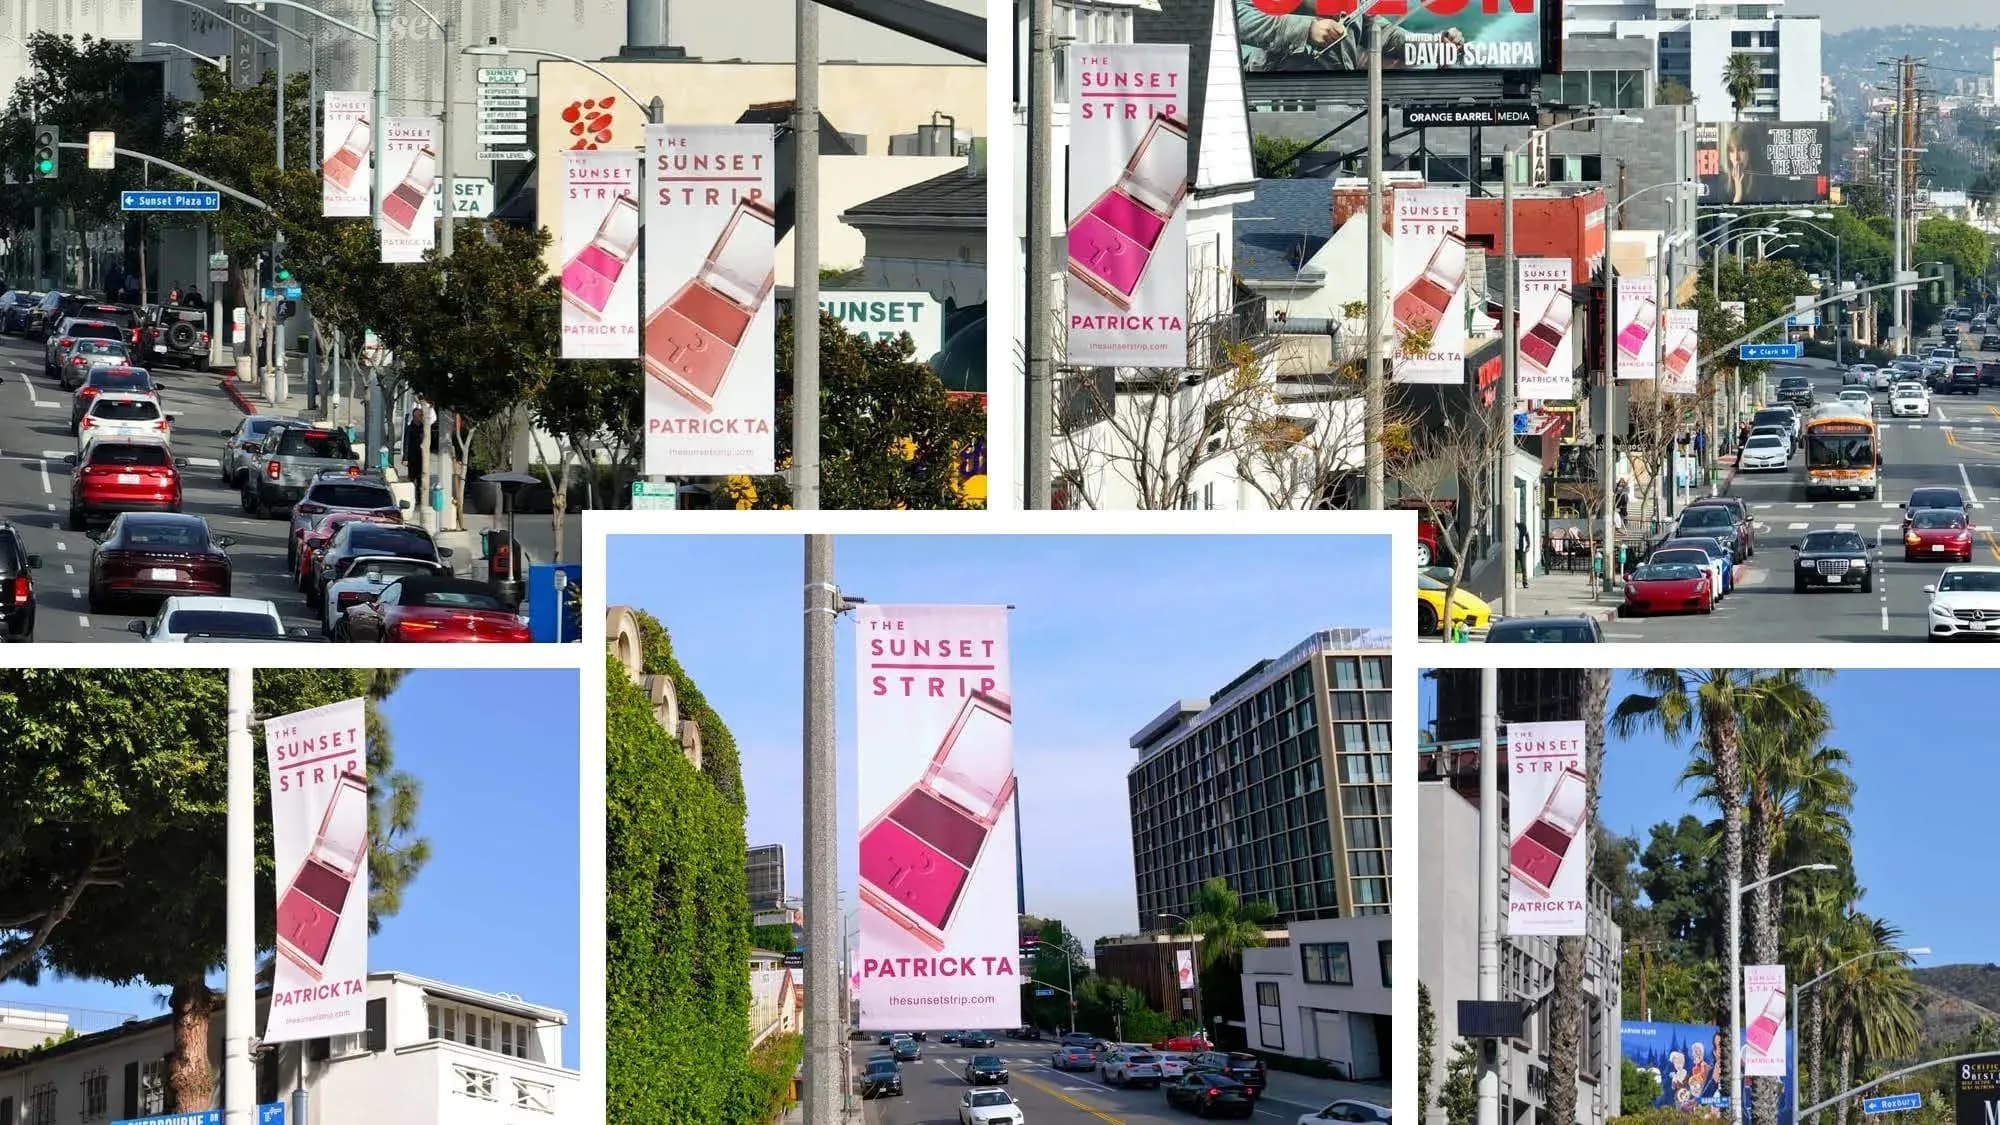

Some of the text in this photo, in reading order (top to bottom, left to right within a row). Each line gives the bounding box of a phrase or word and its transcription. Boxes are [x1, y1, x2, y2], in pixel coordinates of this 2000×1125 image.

[1405, 41, 1535, 65] DAVID SCARPA
[1082, 57, 1108, 65] THE
[1082, 72, 1178, 88] SUNSET
[1082, 103, 1177, 119] STRIP
[1409, 111, 1530, 122] ORANGE BARREL MEDIA
[658, 138, 687, 147] THE
[1793, 128, 1817, 144] BEST
[388, 143, 431, 151] STRIP
[1767, 144, 1823, 159] PICTURE OF
[658, 154, 763, 171] SUNSET
[1772, 159, 1790, 175] THE
[569, 168, 631, 178] SUNSET
[569, 188, 631, 199] STRIP
[659, 187, 762, 205] STRIP
[139, 196, 217, 206] Sunset Plaza Dr
[1401, 206, 1459, 216] SUNSET
[1401, 225, 1459, 235] STRIP
[1524, 270, 1567, 278] SUNSET
[1524, 283, 1567, 292] STRIP
[1071, 315, 1182, 331] PATRICK TA
[564, 325, 635, 335] PATRICK TA
[1448, 352, 1462, 361] TA
[649, 419, 769, 434] PATRICK TA
[870, 621, 905, 631] THE
[871, 638, 994, 658] SUNSET
[873, 675, 996, 698] STRIP
[275, 727, 297, 739] THE
[277, 728, 356, 761] SUNSET
[1515, 740, 1578, 752] SUNSET
[1516, 760, 1578, 774] STRIP
[280, 760, 357, 792] STRIP
[1511, 900, 1583, 912] PATRICK TA
[863, 956, 1014, 978] PATRICK TA
[274, 979, 363, 1008] PATRICK TA
[889, 994, 995, 1007] thesunsetstrip.com
[1962, 1064, 1971, 1080] 8
[1881, 1099, 1916, 1111] Roxbury
